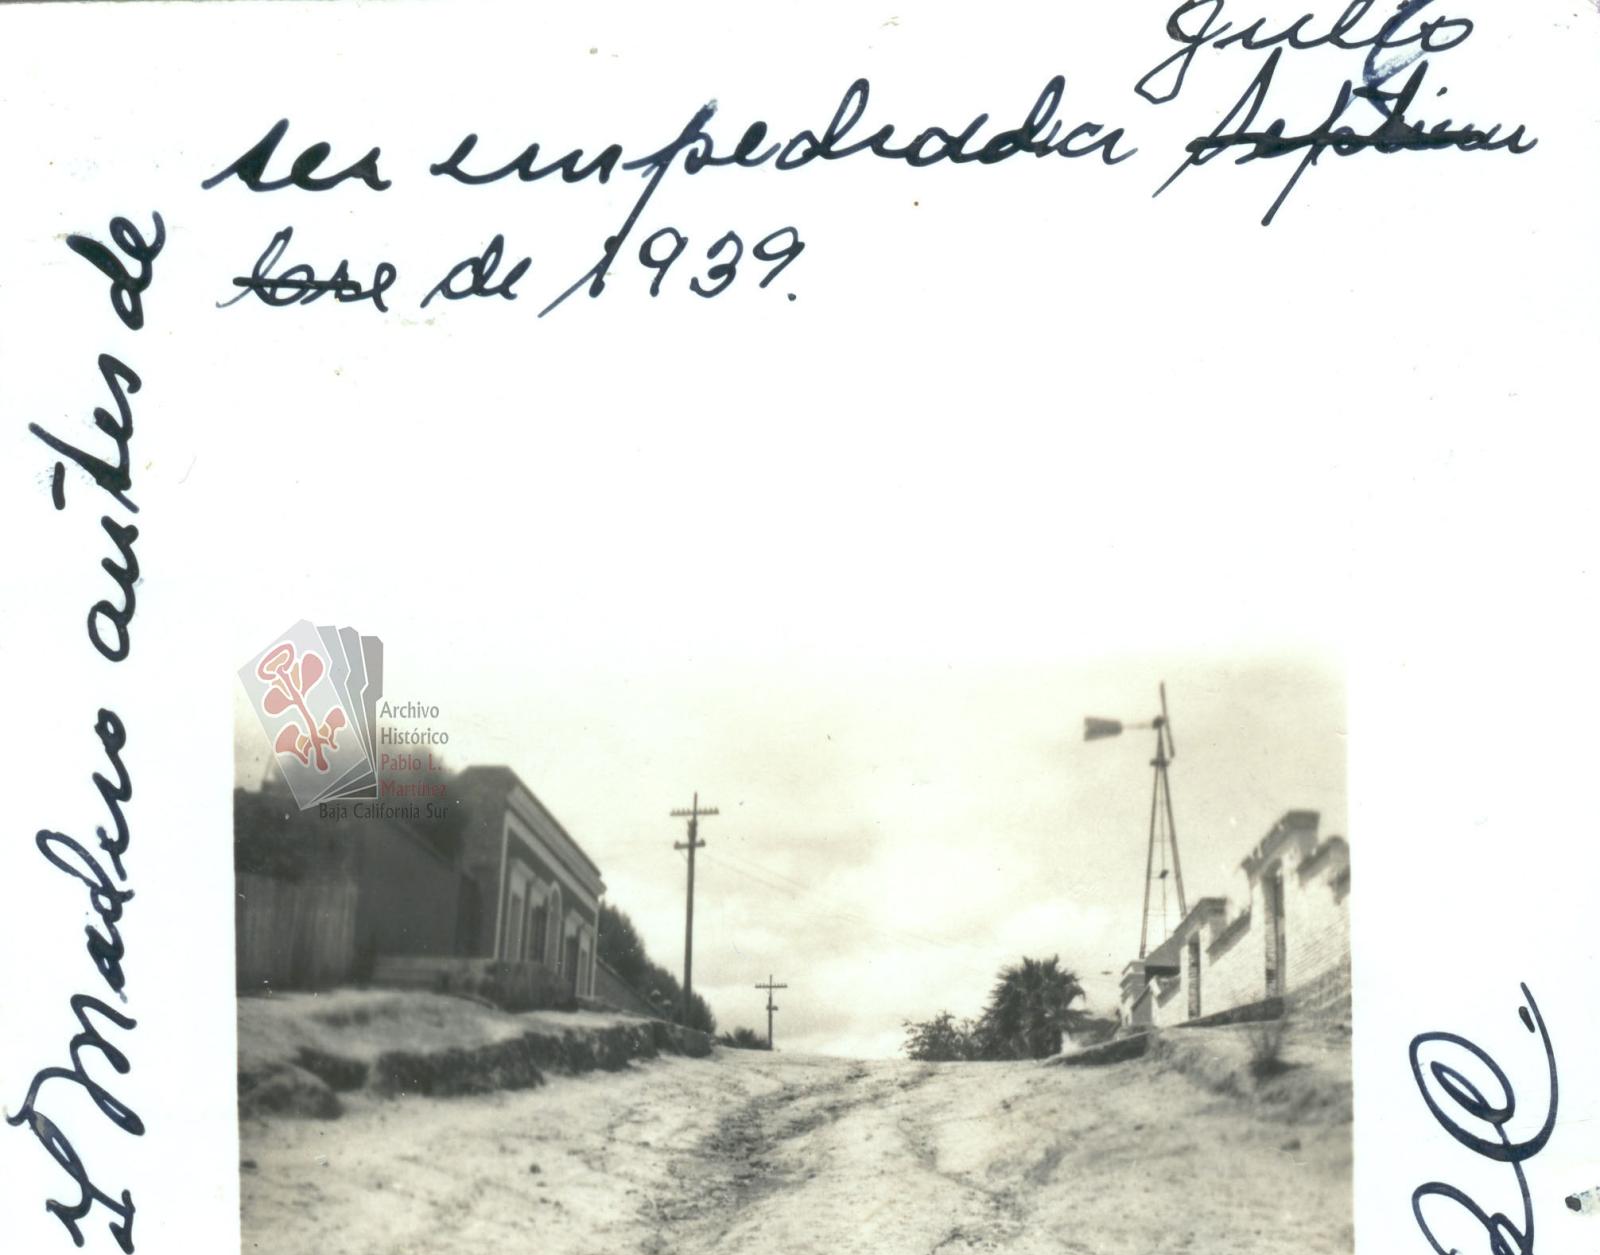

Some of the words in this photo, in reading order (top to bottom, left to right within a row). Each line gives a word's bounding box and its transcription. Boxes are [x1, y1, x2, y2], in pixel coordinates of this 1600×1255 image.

[66, 212, 166, 331] de
[421, 234, 532, 308] de
[31, 354, 142, 662] antes
